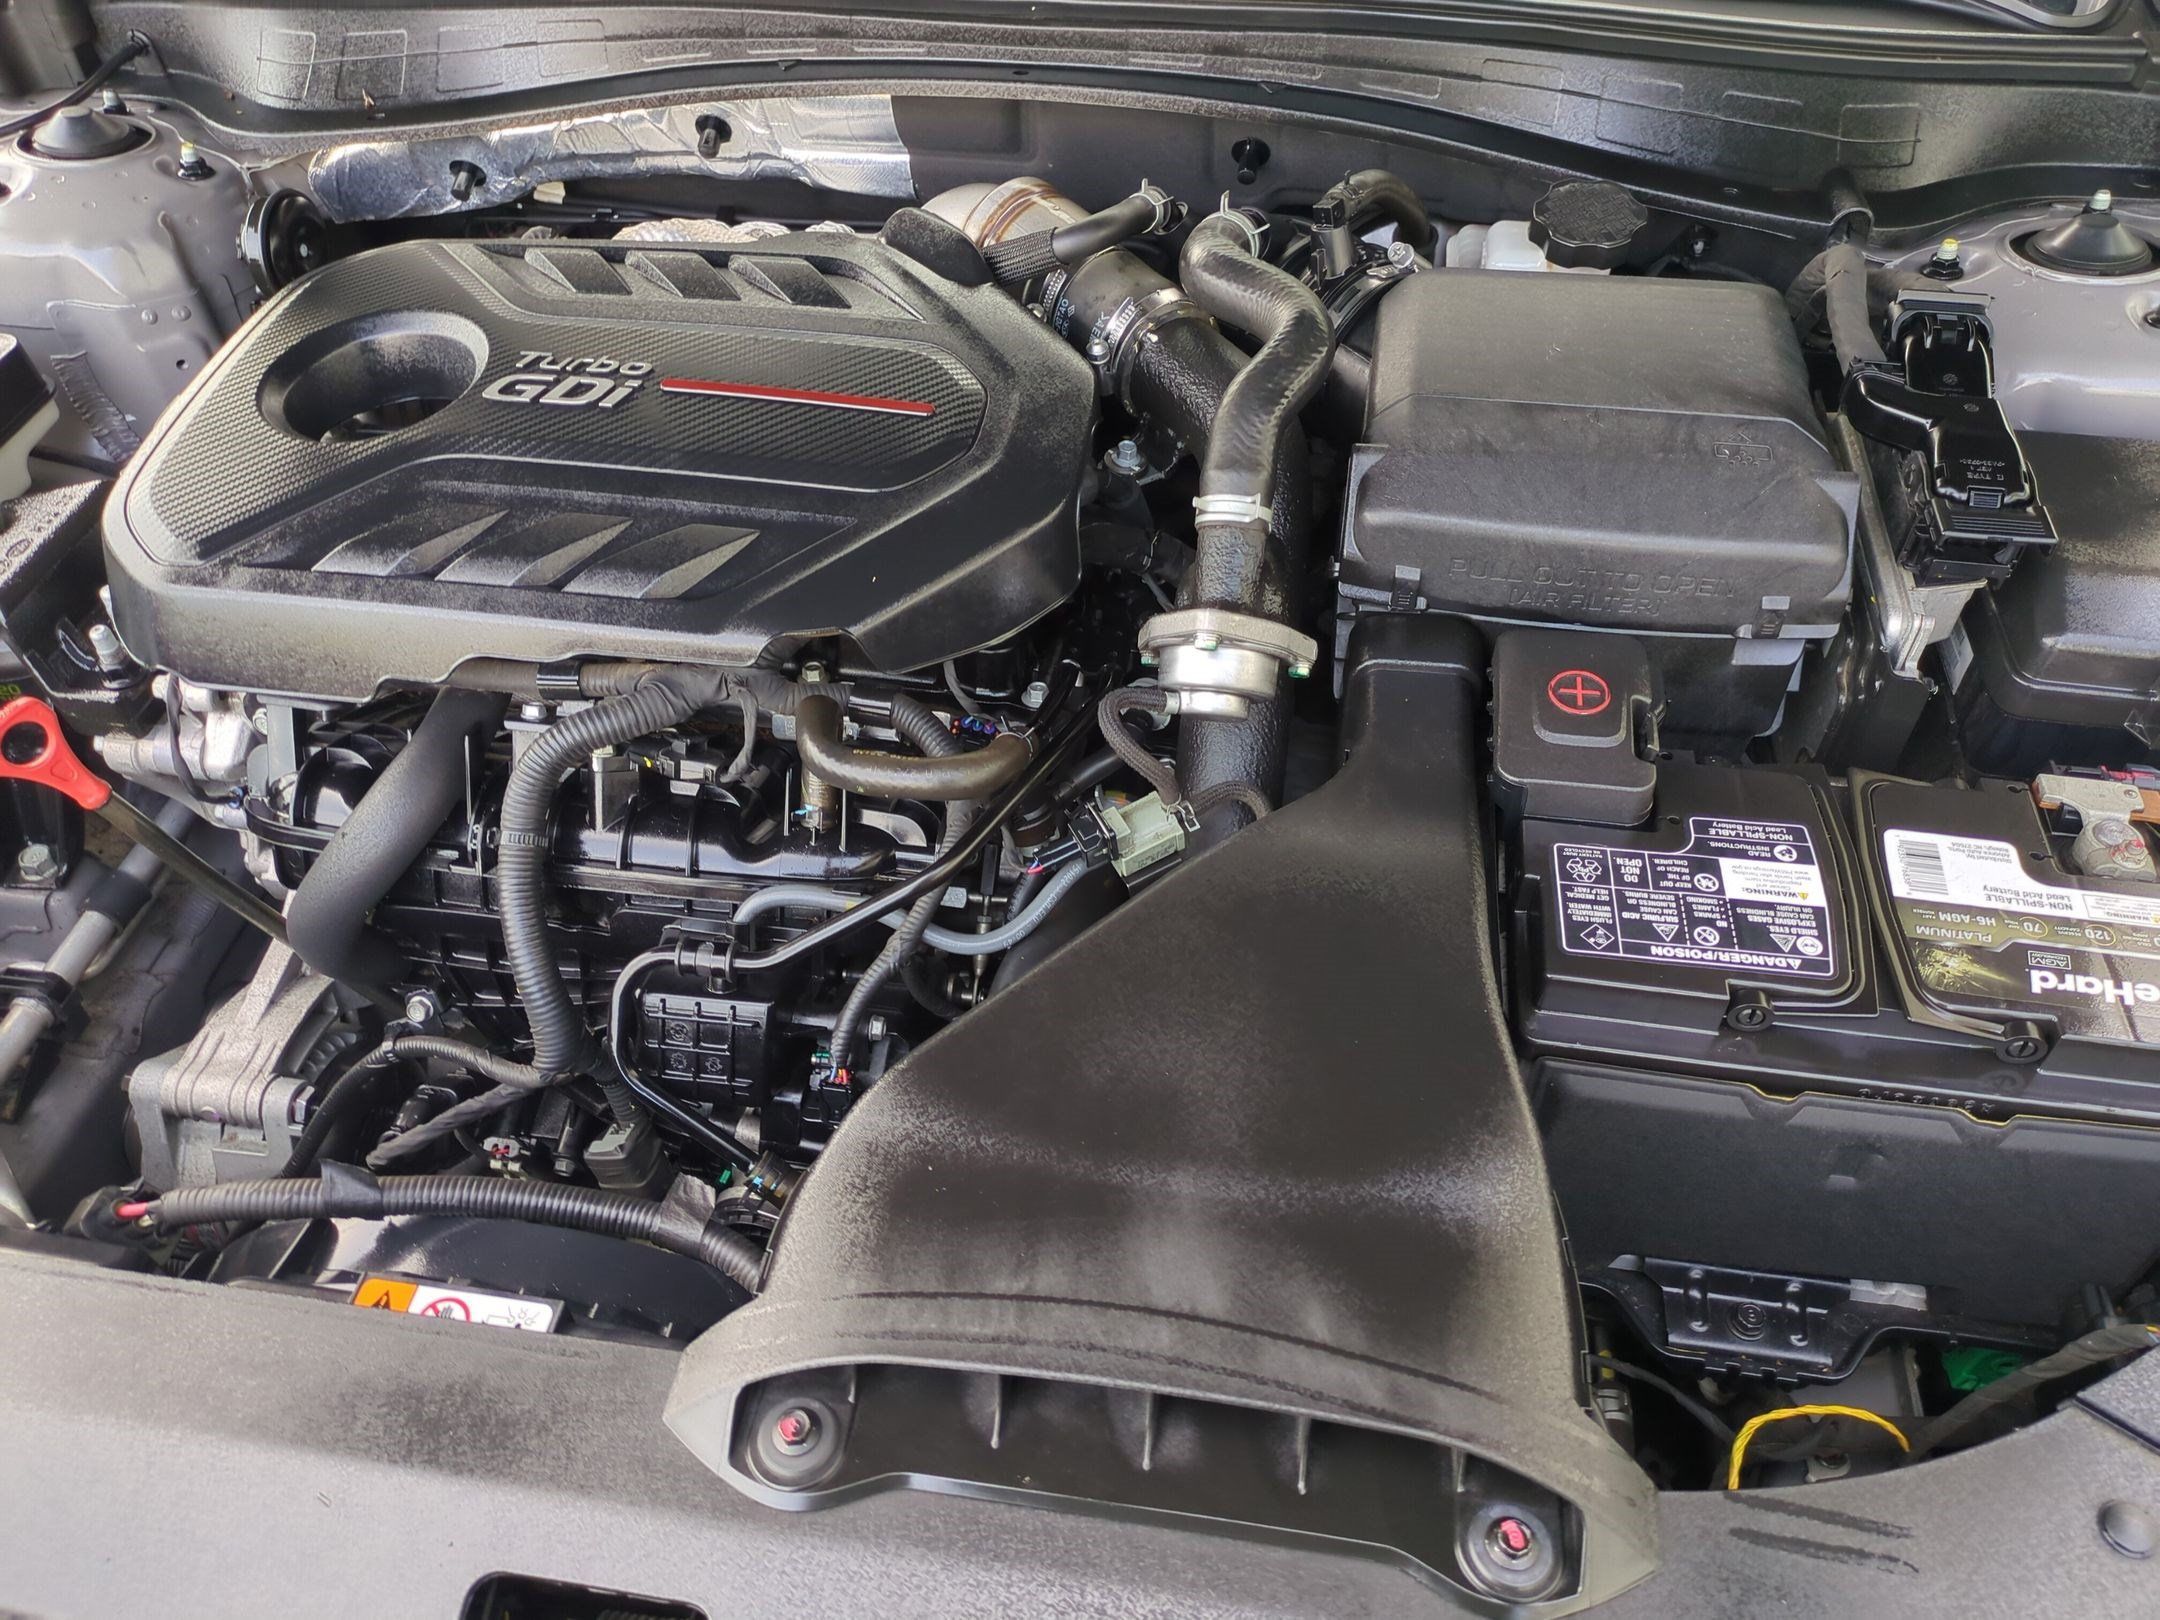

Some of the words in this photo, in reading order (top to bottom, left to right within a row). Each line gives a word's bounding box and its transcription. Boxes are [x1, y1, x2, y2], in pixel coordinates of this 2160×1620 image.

[516, 350, 653, 375] Turbo
[482, 373, 644, 408] GDi
[1449, 559, 1523, 583] PULL
[1532, 566, 1598, 588] OUT
[1605, 571, 1641, 592] TO
[1652, 575, 1736, 598] OPEN
[1712, 822, 1743, 830] Battery
[1708, 828, 1793, 841] NON-SPILLABLE
[1707, 841, 1770, 851] INSTRUCTIONS.
[1613, 857, 1642, 867] OPEN.
[1620, 866, 1640, 874] NOT
[1624, 874, 1638, 883] DO
[1565, 891, 1595, 900] MEDICAL
[1741, 887, 1798, 898] WARNING:
[1983, 885, 2020, 896] Battery
[2022, 891, 2044, 899] Acid
[1686, 896, 1718, 905] SMOKING
[1984, 894, 2073, 911] NON-SPILLABLE
[2046, 893, 2071, 902] Lead
[1640, 899, 1676, 908] BLINDNESS
[1567, 909, 1612, 918] IMMEDIATELY
[1736, 907, 1775, 916] BLINDNESS
[1642, 914, 1679, 923] SULFURIC
[1747, 915, 1773, 923] GASES
[1774, 917, 1816, 927] EXPLOSIVE
[1938, 912, 1996, 926] H6-AGM
[1791, 928, 1818, 936] SHIELD
[2023, 922, 2042, 932] 70
[1916, 925, 1992, 943] PLATINUM
[2084, 929, 2111, 940] 120
[1650, 945, 1788, 968] DANGER/POISON
[2031, 957, 2067, 967] AGM
[2030, 969, 2160, 1006] eHard
